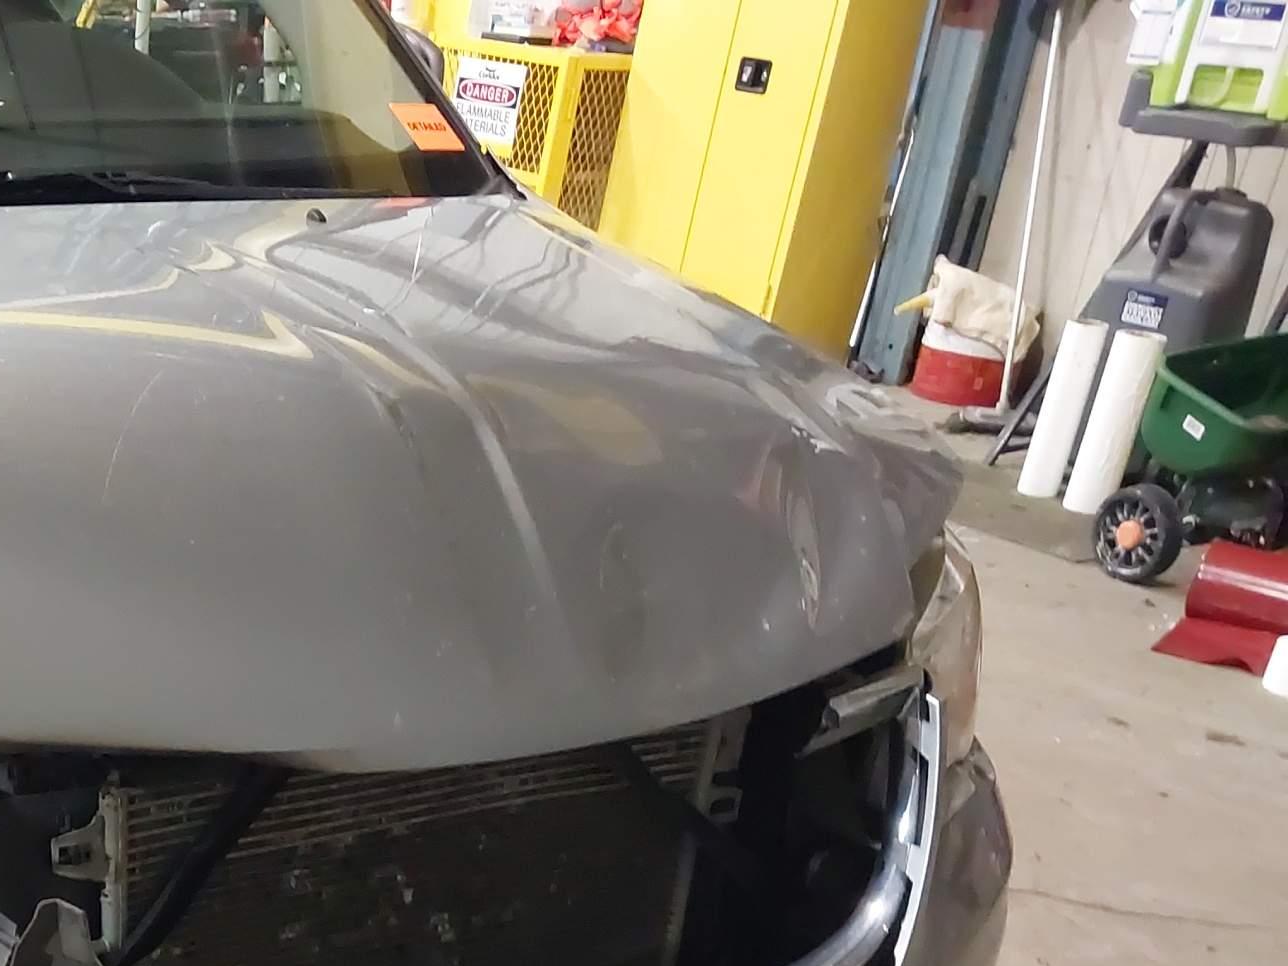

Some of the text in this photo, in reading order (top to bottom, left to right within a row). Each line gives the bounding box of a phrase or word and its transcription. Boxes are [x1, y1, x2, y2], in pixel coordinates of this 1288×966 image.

[466, 82, 509, 103] DANGER
[457, 102, 510, 124] FLAMMABLE
[465, 118, 507, 137] TERIALS
